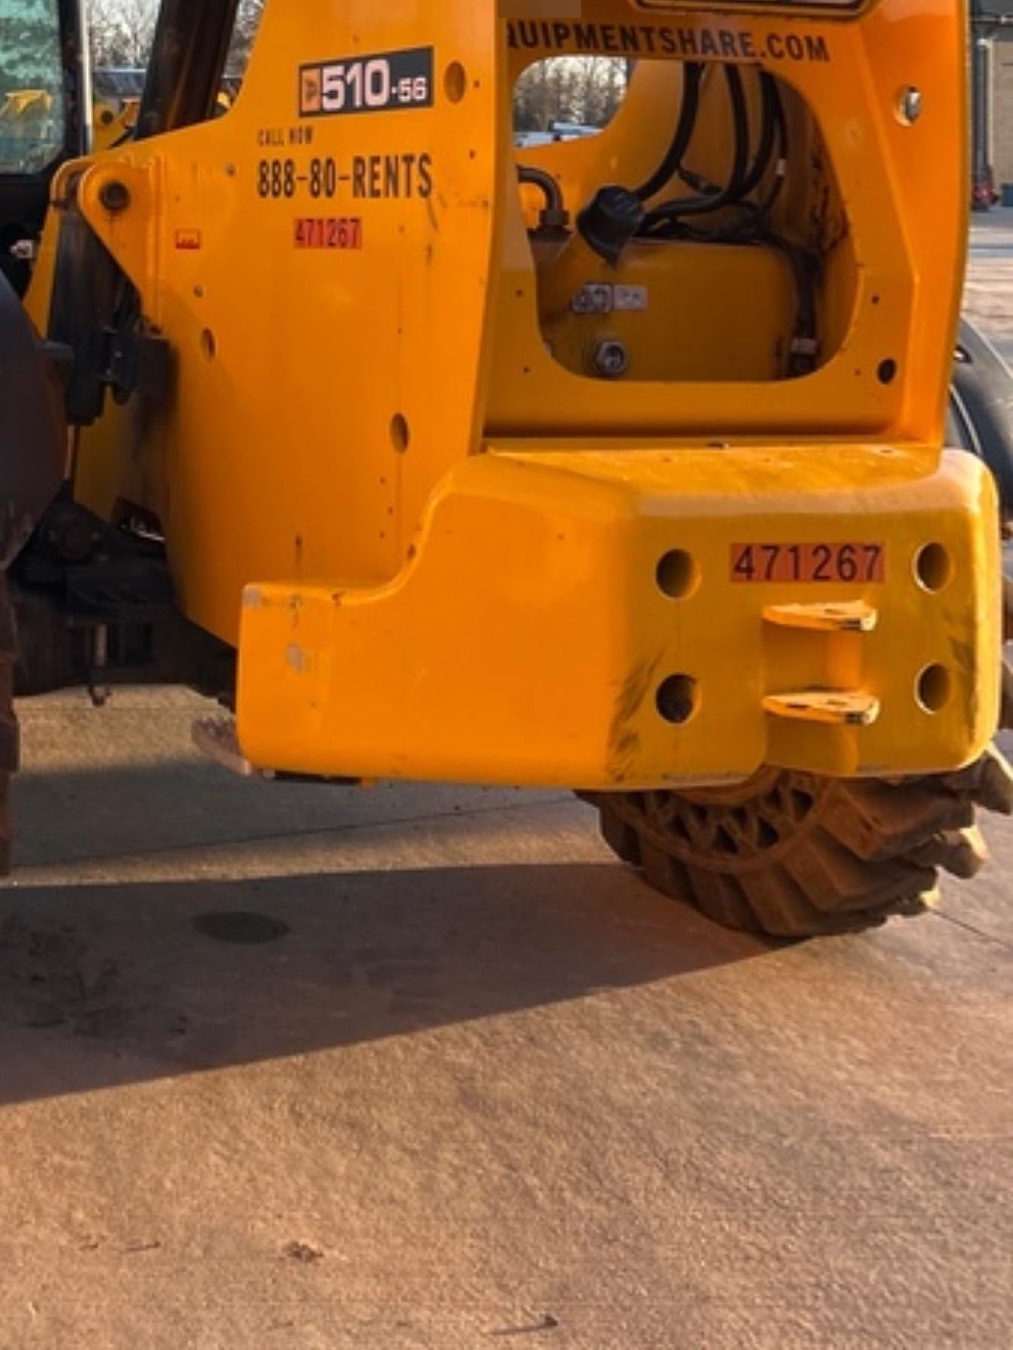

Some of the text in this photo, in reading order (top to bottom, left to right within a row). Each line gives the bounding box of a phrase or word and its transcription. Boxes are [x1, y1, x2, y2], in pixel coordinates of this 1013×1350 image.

[507, 19, 830, 61] QUIPMENTSHARE.COM
[258, 153, 433, 199] 888-80-RENTS
[295, 217, 361, 248] 471267
[733, 543, 882, 582] 471267
